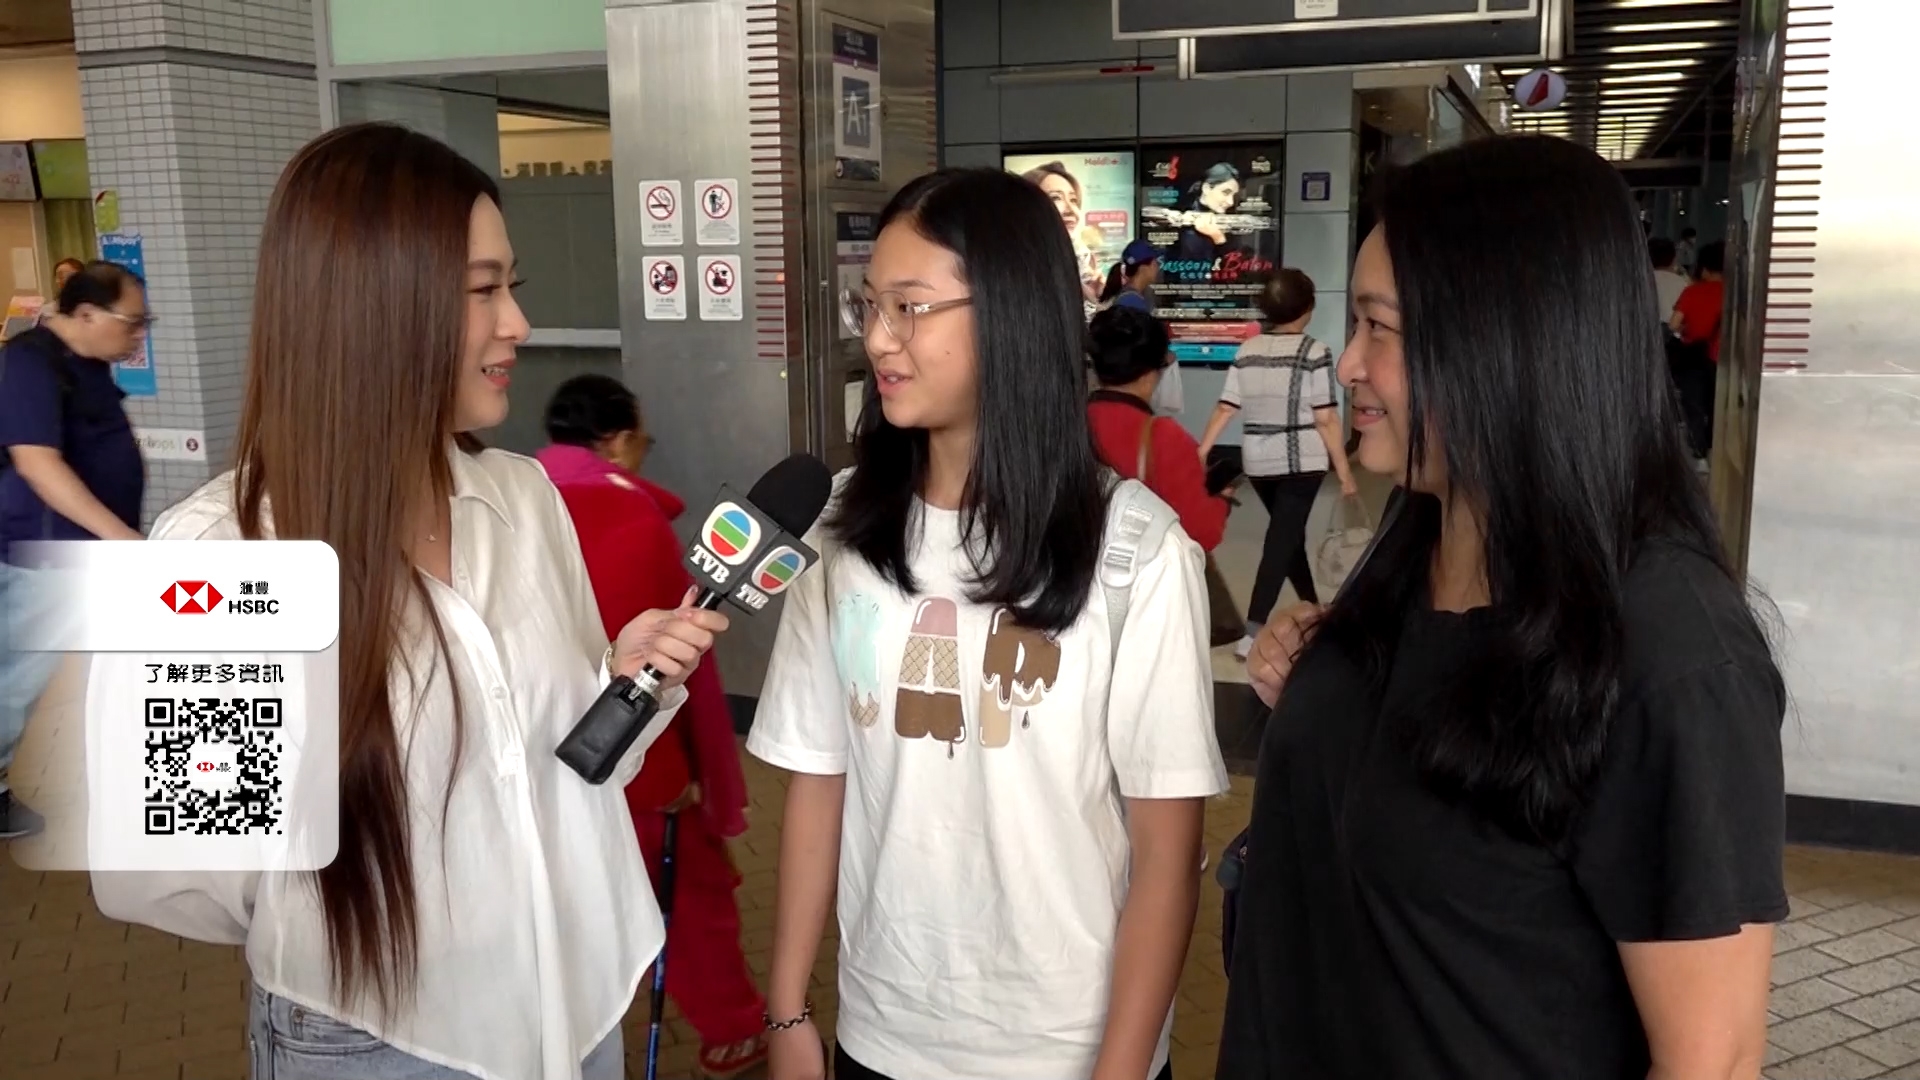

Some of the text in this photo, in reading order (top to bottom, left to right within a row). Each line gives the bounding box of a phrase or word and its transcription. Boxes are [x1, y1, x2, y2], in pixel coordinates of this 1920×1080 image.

[847, 91, 867, 136] A1
[1212, 257, 1222, 271] &
[1223, 252, 1273, 272] Baton
[690, 544, 730, 584] TVB
[735, 582, 769, 610] TVB
